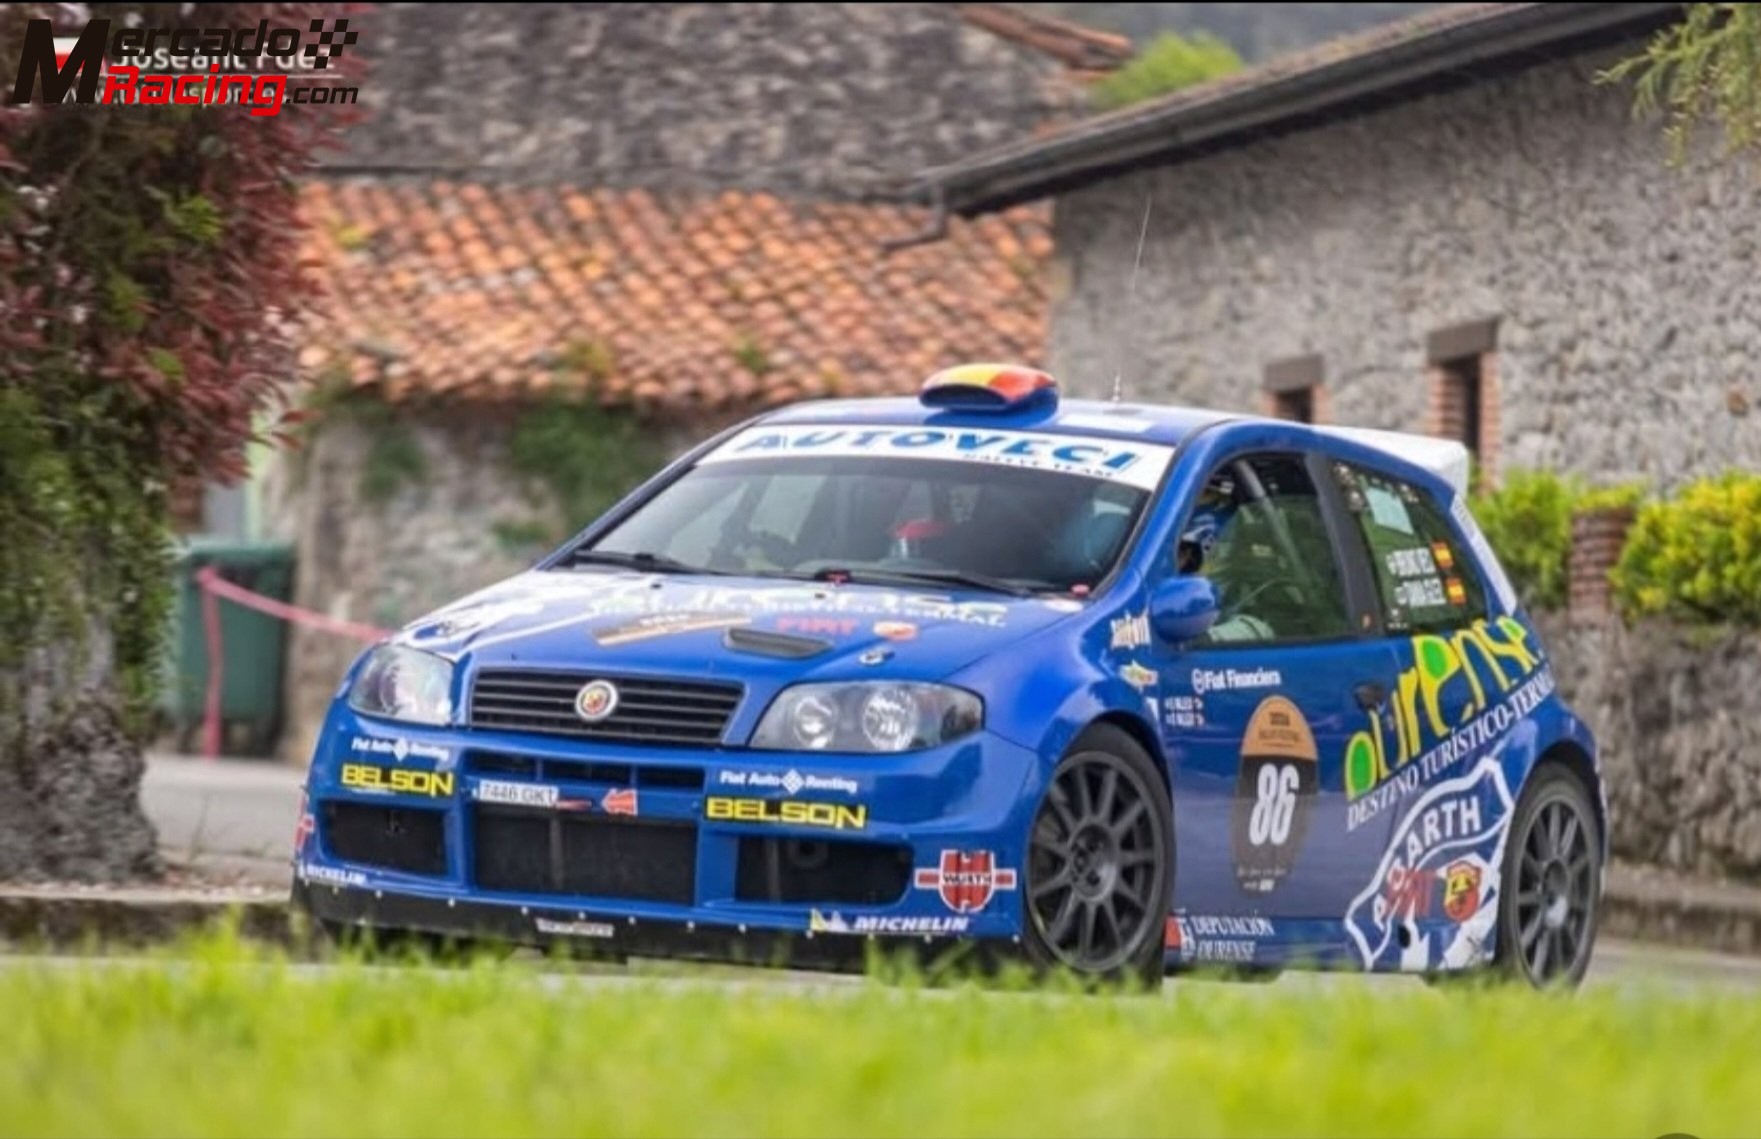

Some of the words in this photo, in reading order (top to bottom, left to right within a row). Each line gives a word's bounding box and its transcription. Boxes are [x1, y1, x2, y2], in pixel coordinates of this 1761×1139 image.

[734, 431, 1137, 470] AUTOVECI
[342, 763, 454, 798] BELSON
[720, 770, 748, 785] Fiat
[748, 771, 780, 787] Auto
[803, 773, 858, 794] Renting
[706, 797, 867, 830] BELSON
[1249, 763, 1299, 846] 86
[853, 915, 969, 932] MICHELIN
